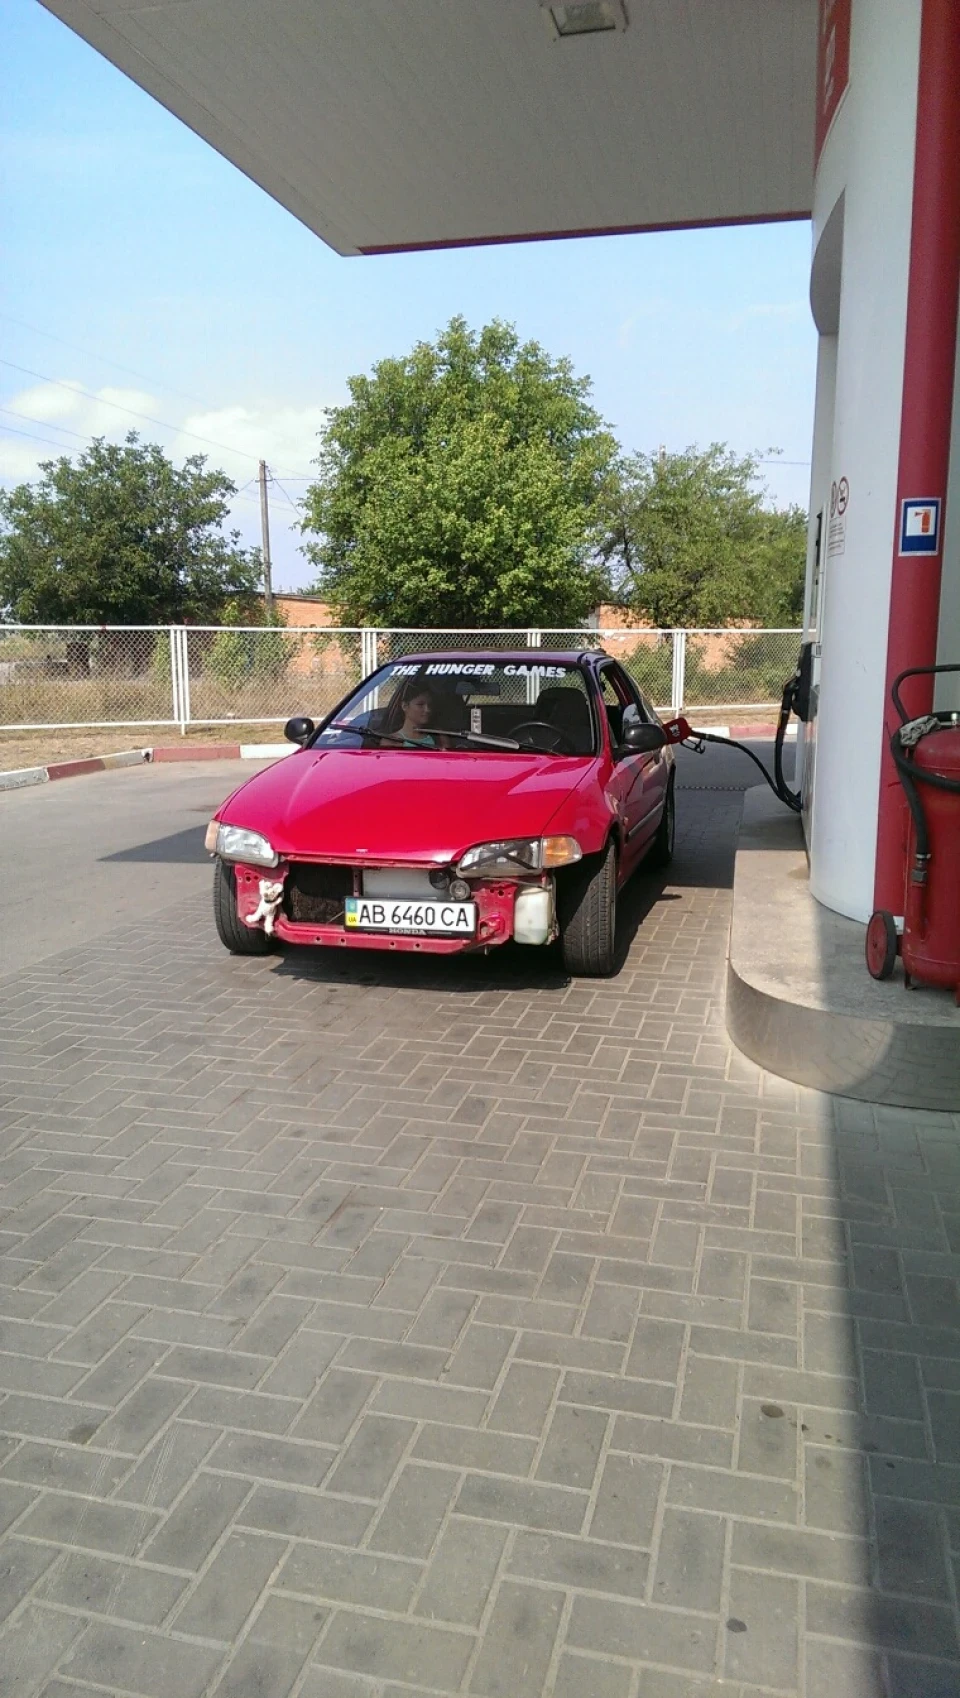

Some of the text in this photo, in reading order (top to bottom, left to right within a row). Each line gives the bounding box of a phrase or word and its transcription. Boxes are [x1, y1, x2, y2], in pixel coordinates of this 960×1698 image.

[389, 664, 566, 678] THE HUNGER GAMES
[359, 904, 469, 927] AB 6460 CA
